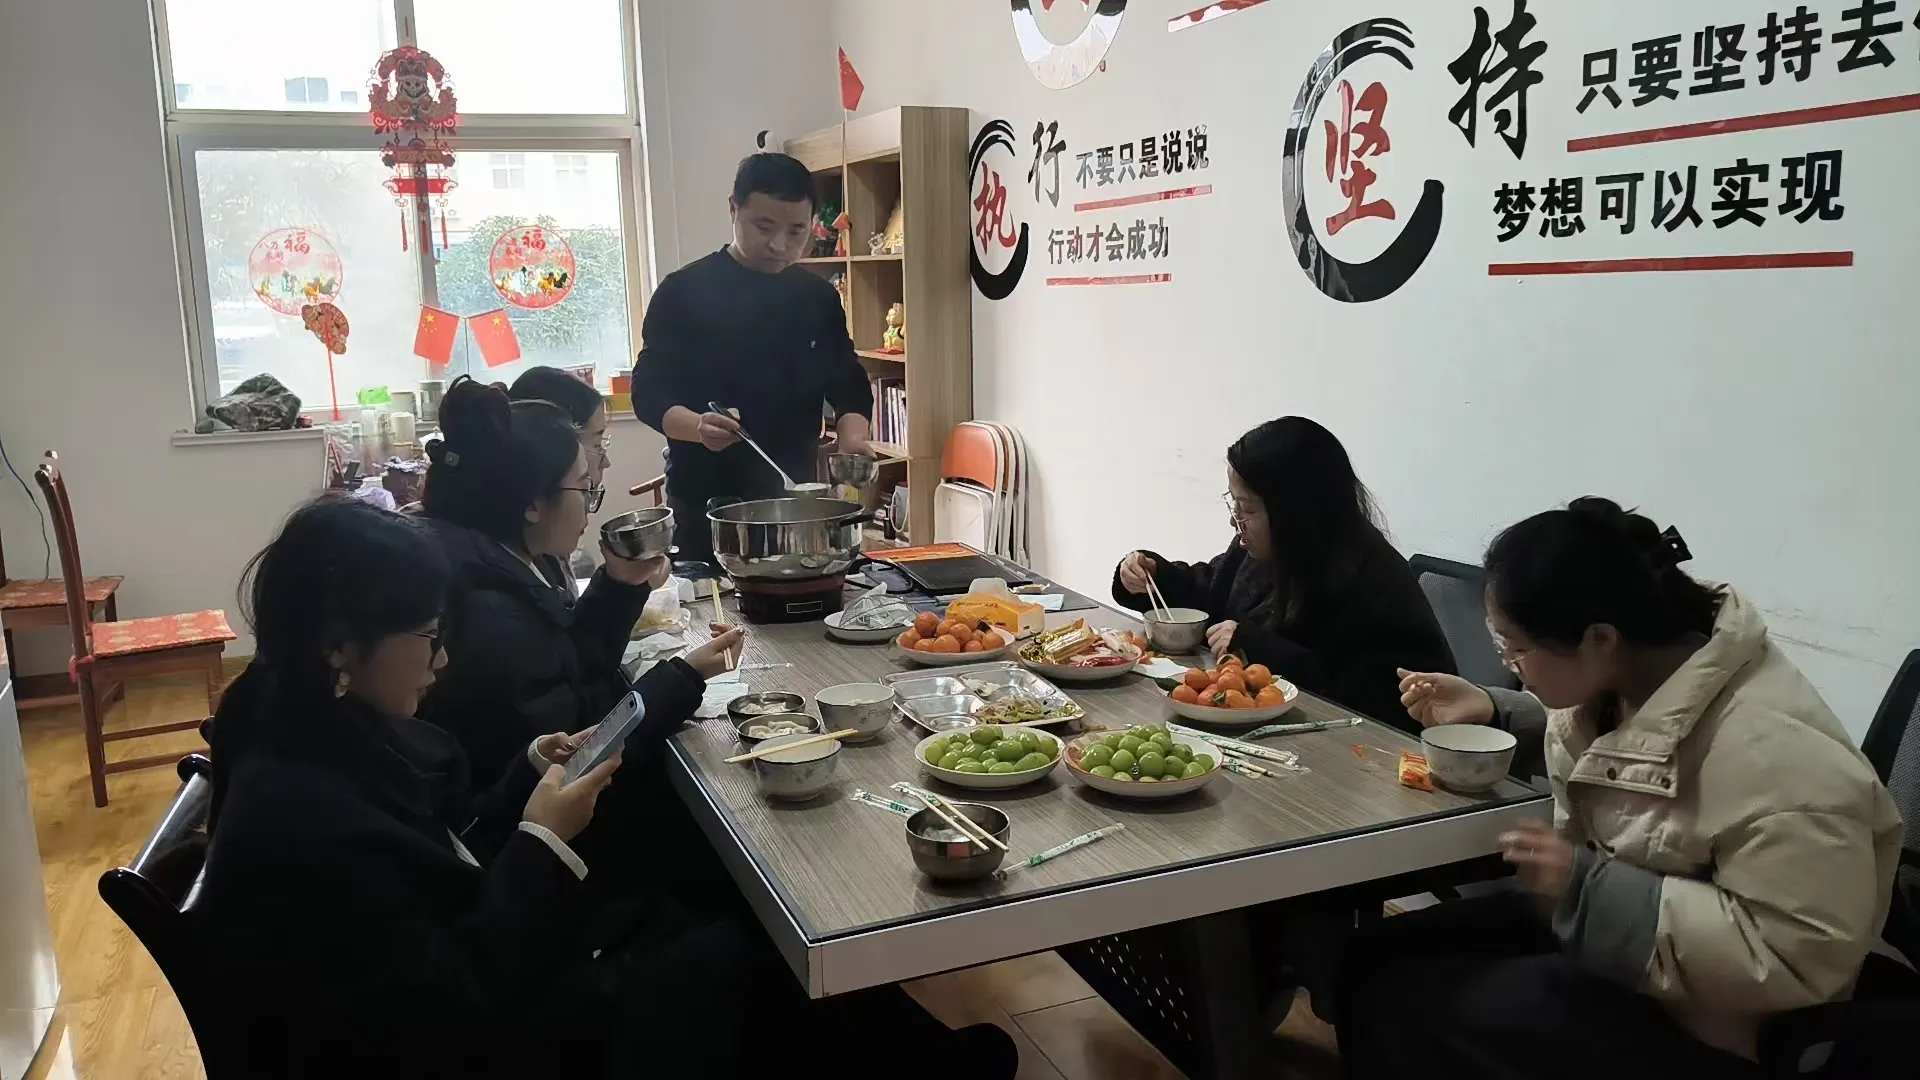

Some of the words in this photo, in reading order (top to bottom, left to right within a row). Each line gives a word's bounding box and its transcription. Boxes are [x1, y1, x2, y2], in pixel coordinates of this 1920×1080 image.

[1447, 0, 1548, 160] 持
[1575, 0, 1920, 115] 只要坚持去
[1027, 118, 1067, 207] 行
[1075, 124, 1210, 190] 不要只是说说
[1325, 80, 1398, 236] 坚
[1492, 150, 1845, 243] 梦想可以实现
[284, 231, 311, 255] 福
[522, 229, 547, 252] 福
[974, 161, 1016, 255] 执
[1047, 216, 1169, 265] 行动才会成功
